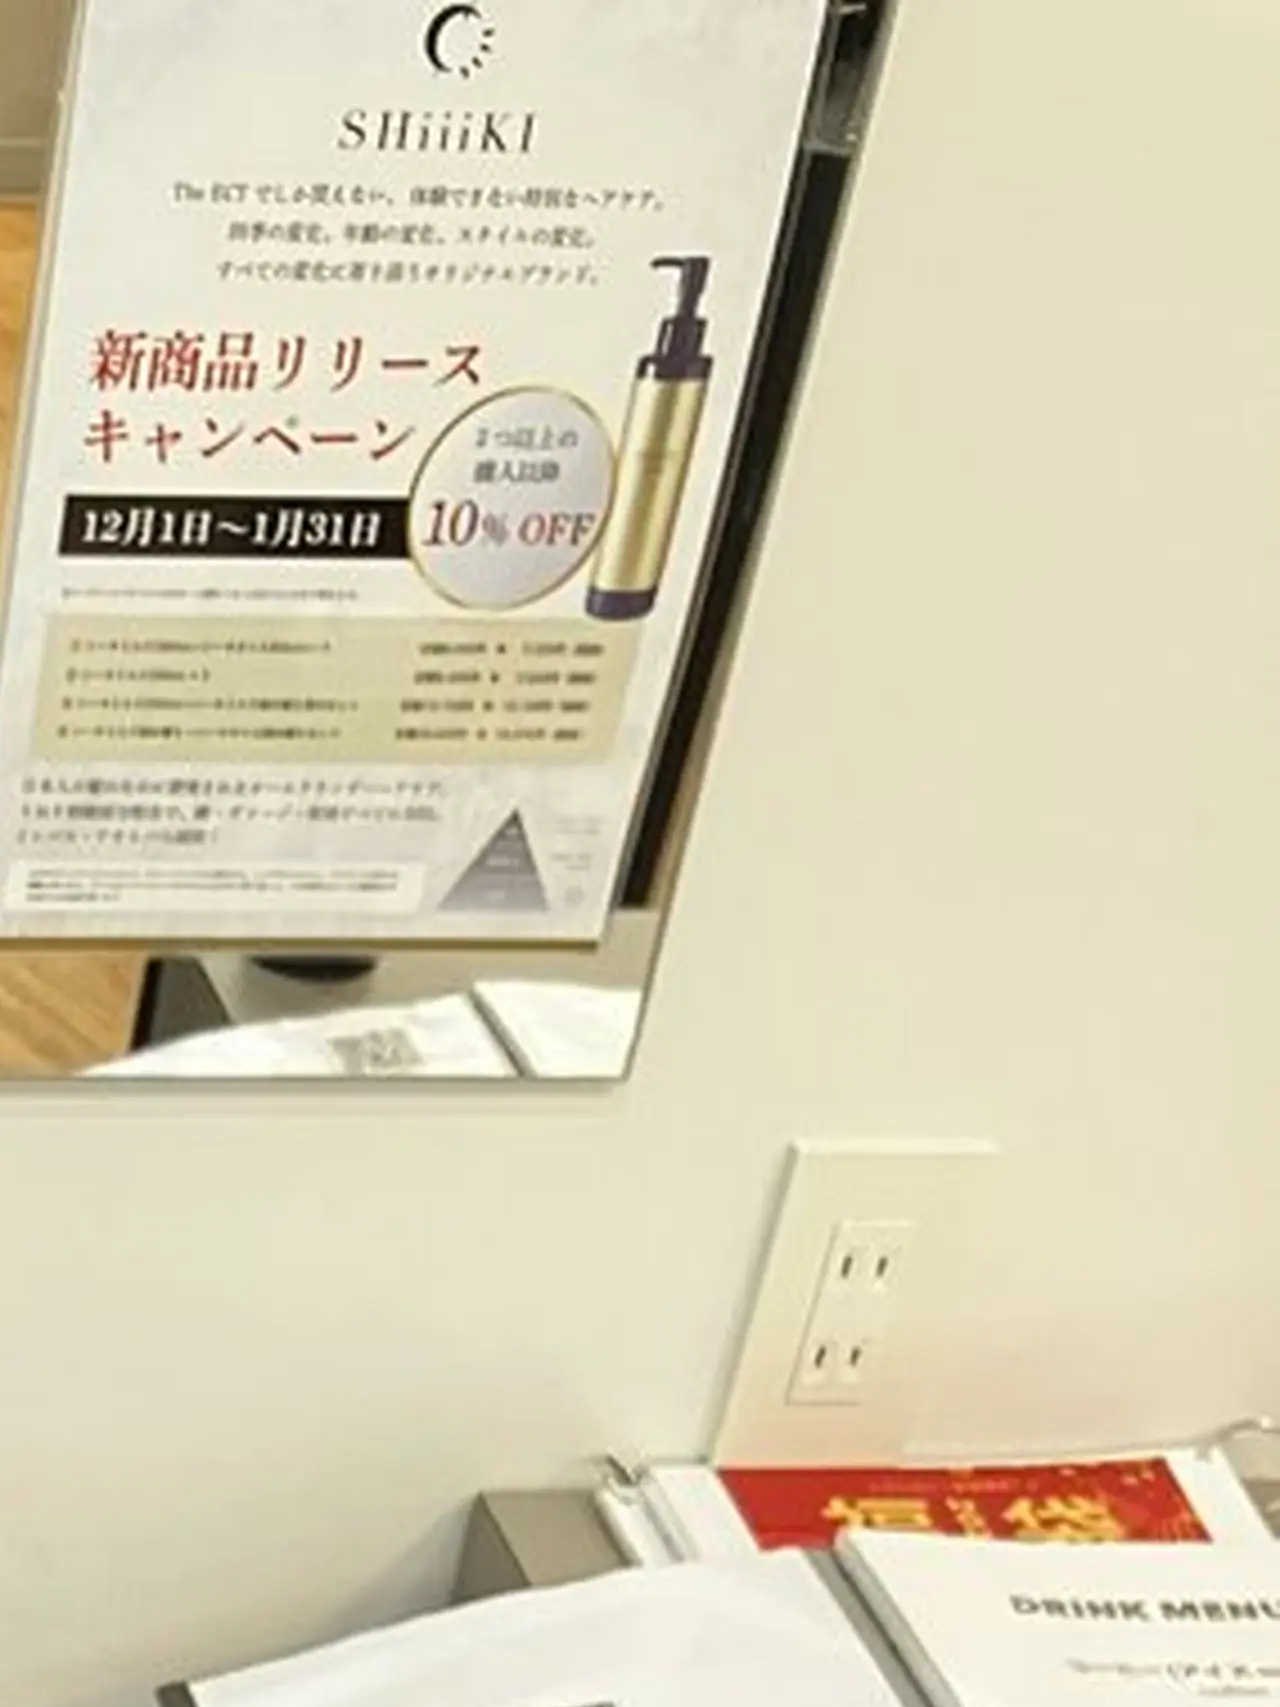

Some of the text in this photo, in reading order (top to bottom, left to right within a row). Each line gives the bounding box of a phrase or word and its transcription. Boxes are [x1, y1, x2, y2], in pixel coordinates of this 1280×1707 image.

[91, 328, 483, 394] 新商品リリース
[83, 409, 416, 464] キャンペーン
[518, 512, 597, 546] OFF
[1009, 1595, 1151, 1621] DRINK
